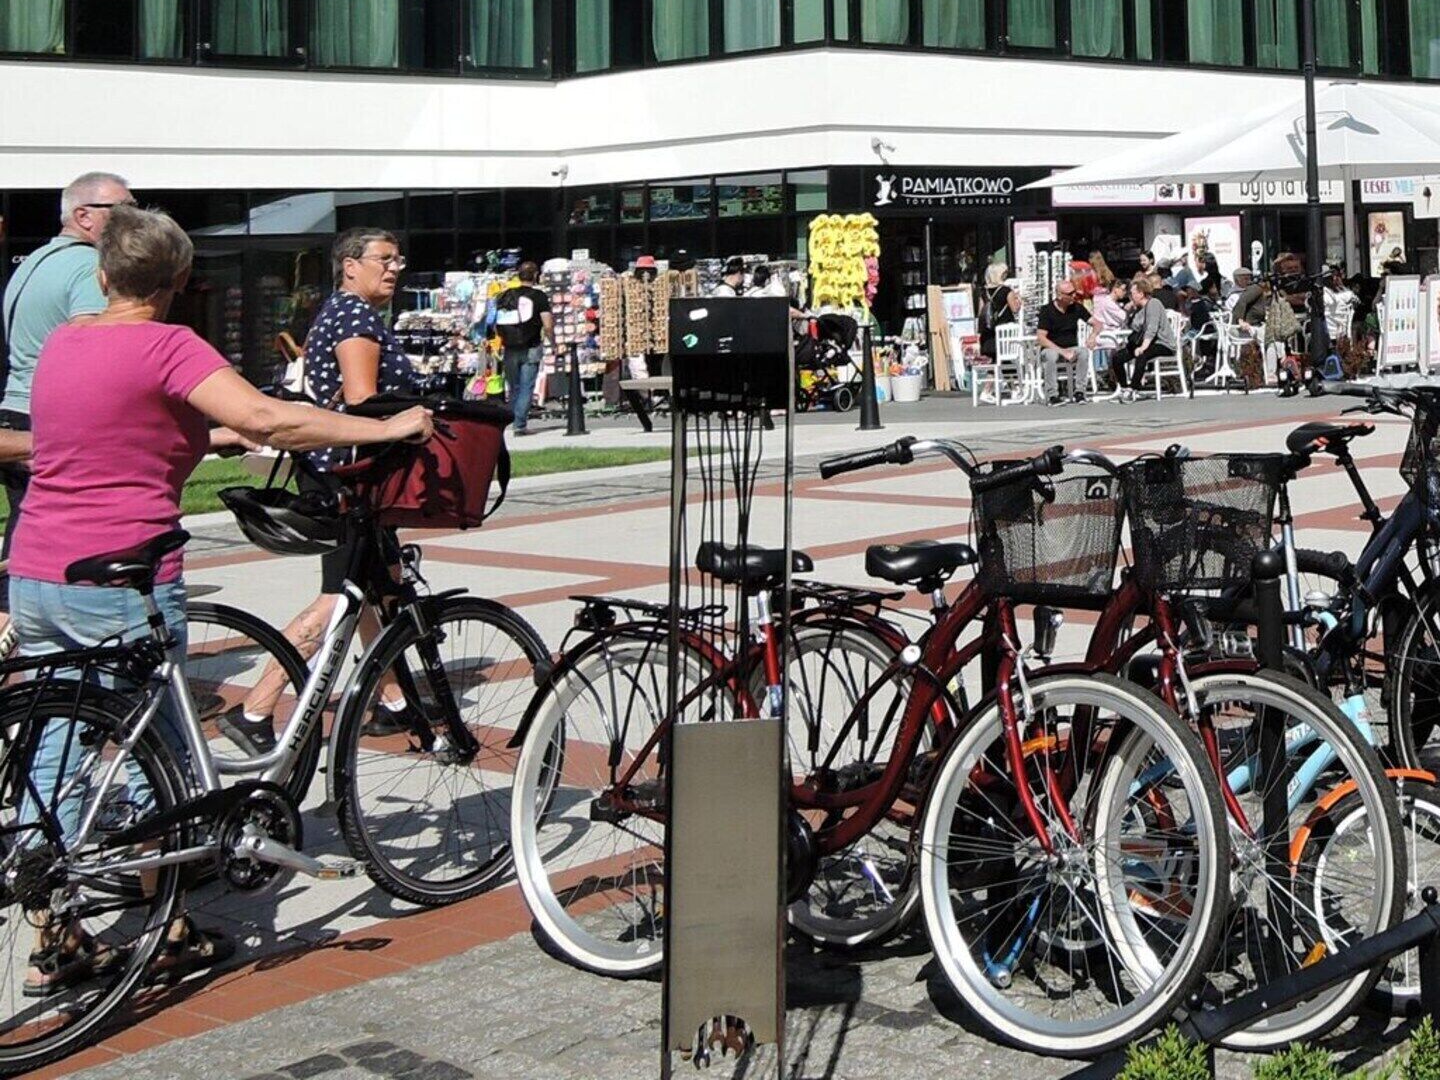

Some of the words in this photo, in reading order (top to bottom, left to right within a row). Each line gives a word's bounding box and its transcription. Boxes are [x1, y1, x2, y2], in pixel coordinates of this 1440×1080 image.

[902, 177, 1013, 196] PAMIĄTKOWO
[954, 197, 1012, 205] SOUVENIRS
[289, 638, 345, 751] HERCULES
